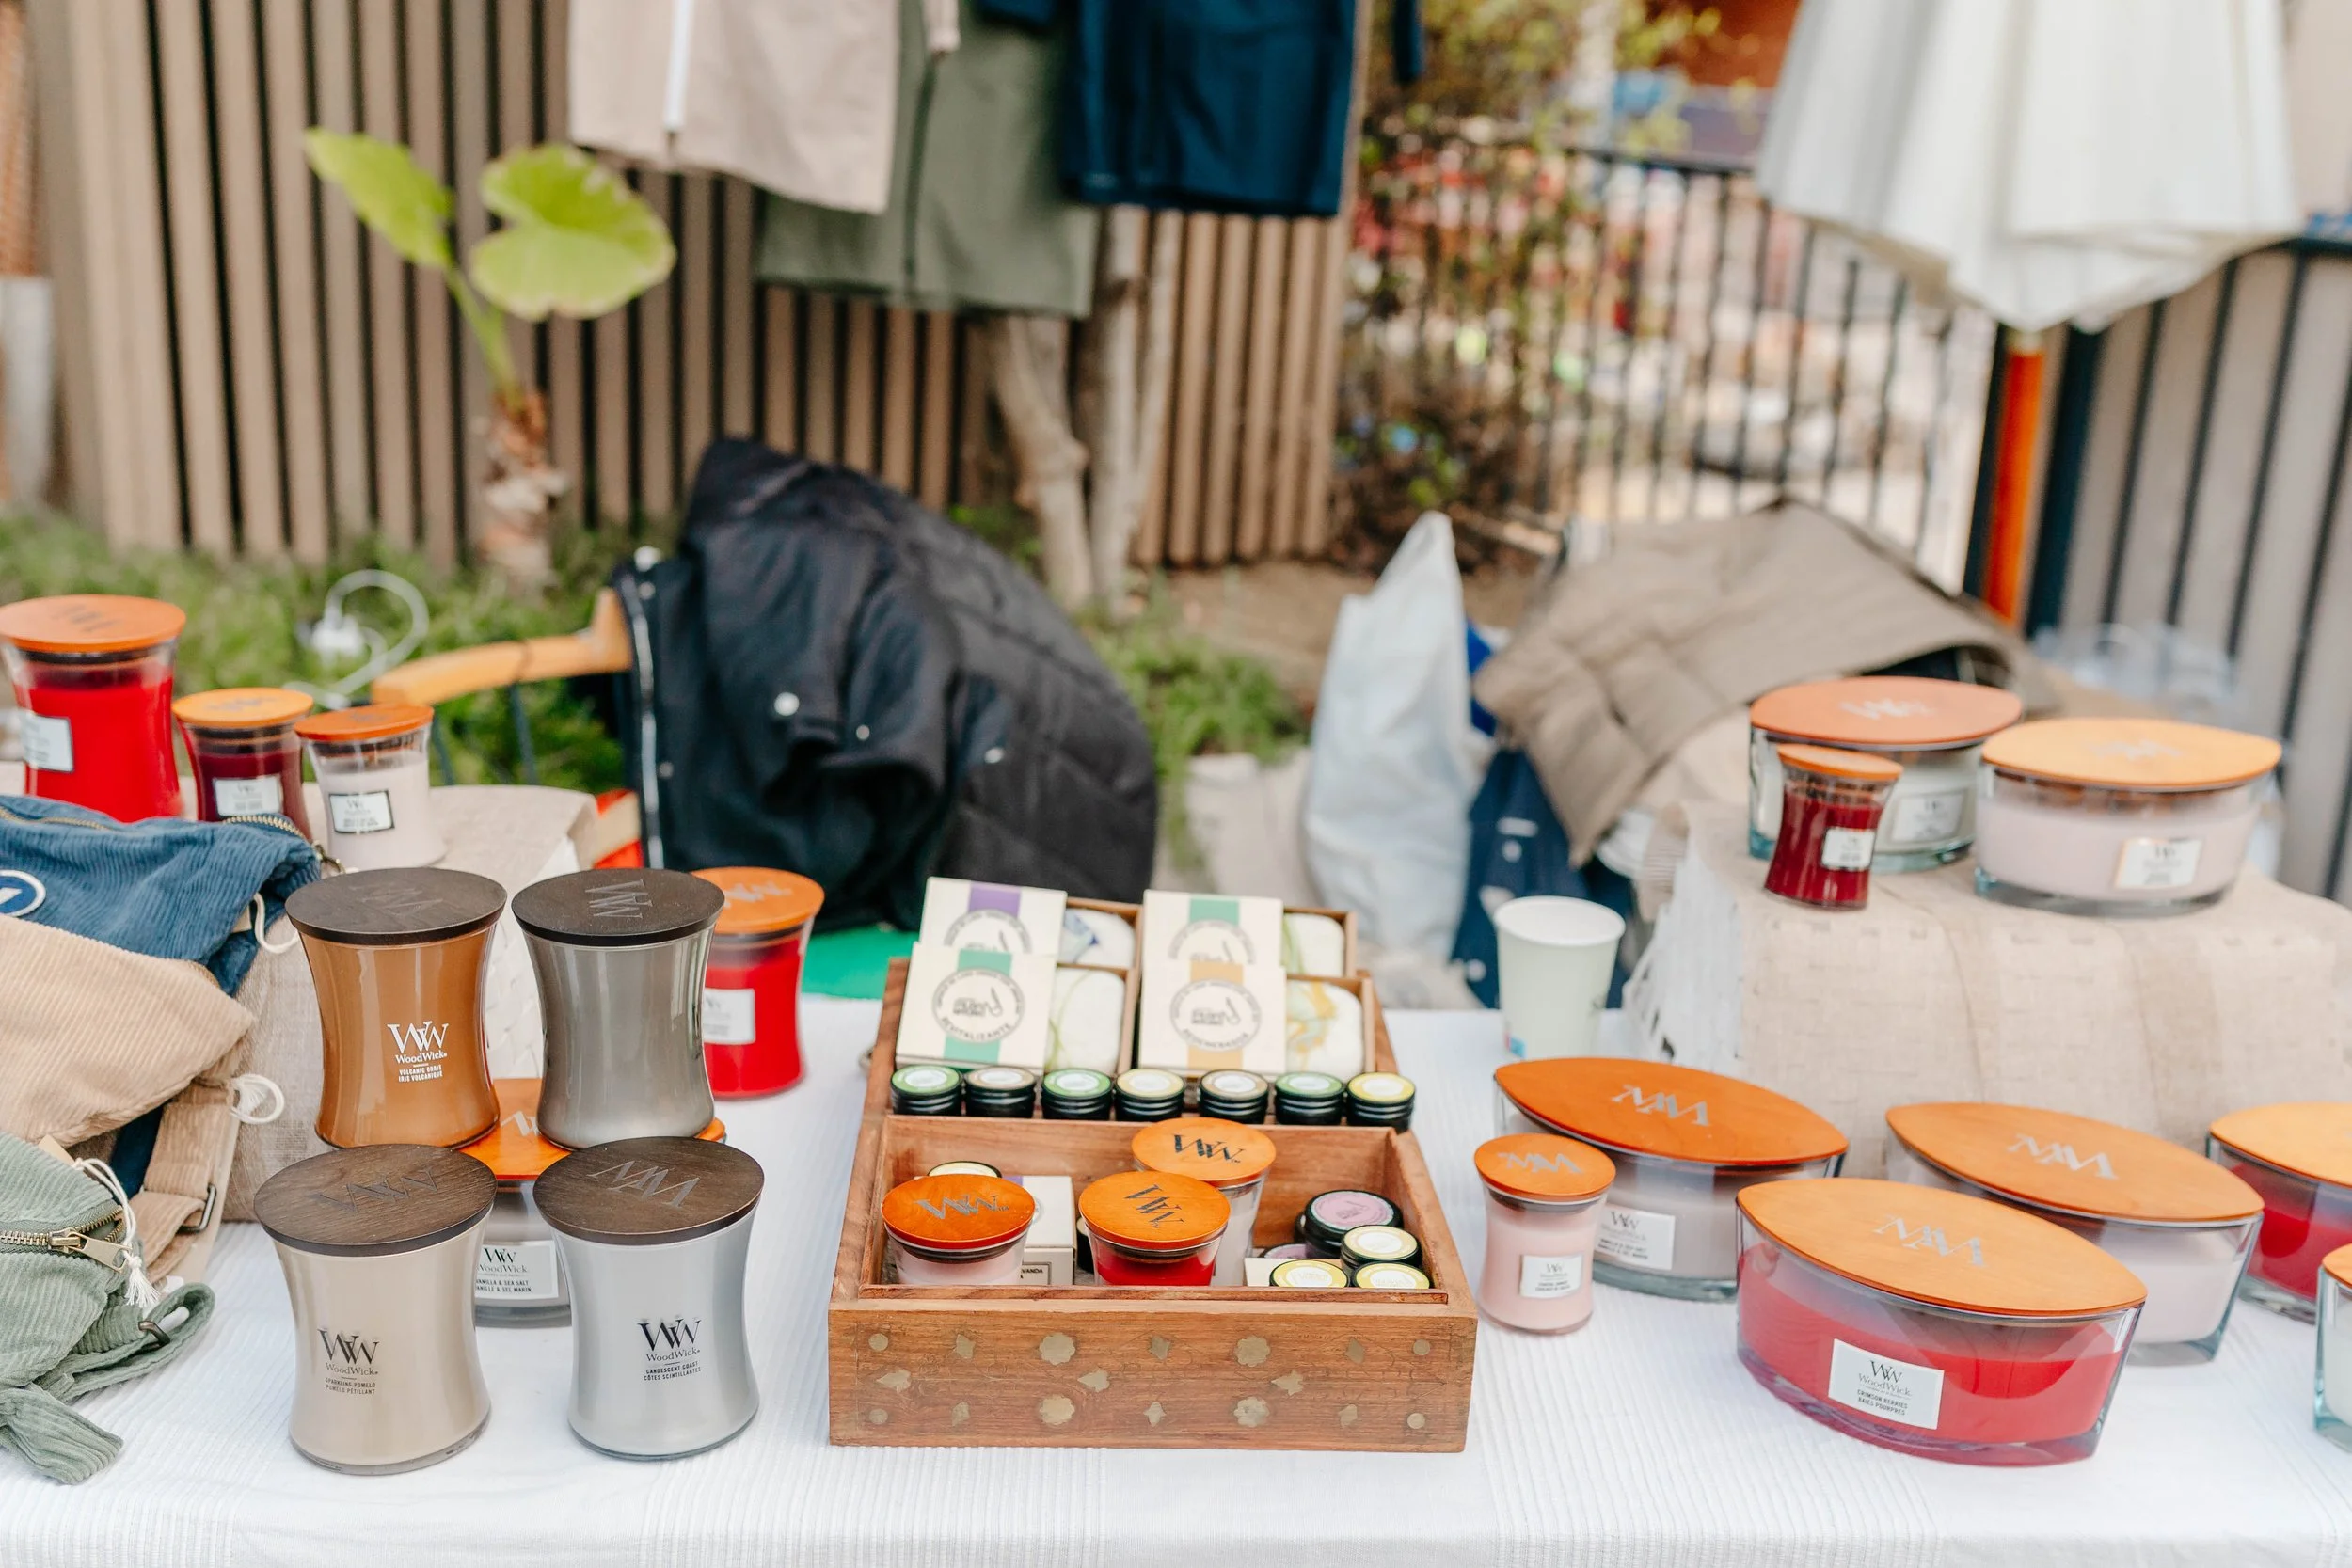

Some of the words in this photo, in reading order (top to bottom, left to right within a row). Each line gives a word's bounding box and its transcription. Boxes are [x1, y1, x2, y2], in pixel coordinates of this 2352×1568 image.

[387, 1021, 449, 1053] WW
[395, 1050, 447, 1064] WoodWick
[399, 1067, 425, 1075] VOLCANIC
[411, 1070, 443, 1082] VOLCANIQUE
[1173, 1134, 1246, 1161] WW
[913, 1194, 998, 1219] WW
[484, 1247, 516, 1263] WW
[637, 1318, 702, 1352] WW
[317, 1328, 380, 1365] WW
[646, 1347, 701, 1362] WoodWick
[326, 1362, 379, 1376] WoodWick
[645, 1365, 681, 1374] CANDESCENT
[682, 1361, 699, 1370] COAST
[662, 1366, 702, 1380] SCINTILLANTES
[1870, 1360, 1902, 1383] WW
[1858, 1372, 1911, 1396] WoodWick
